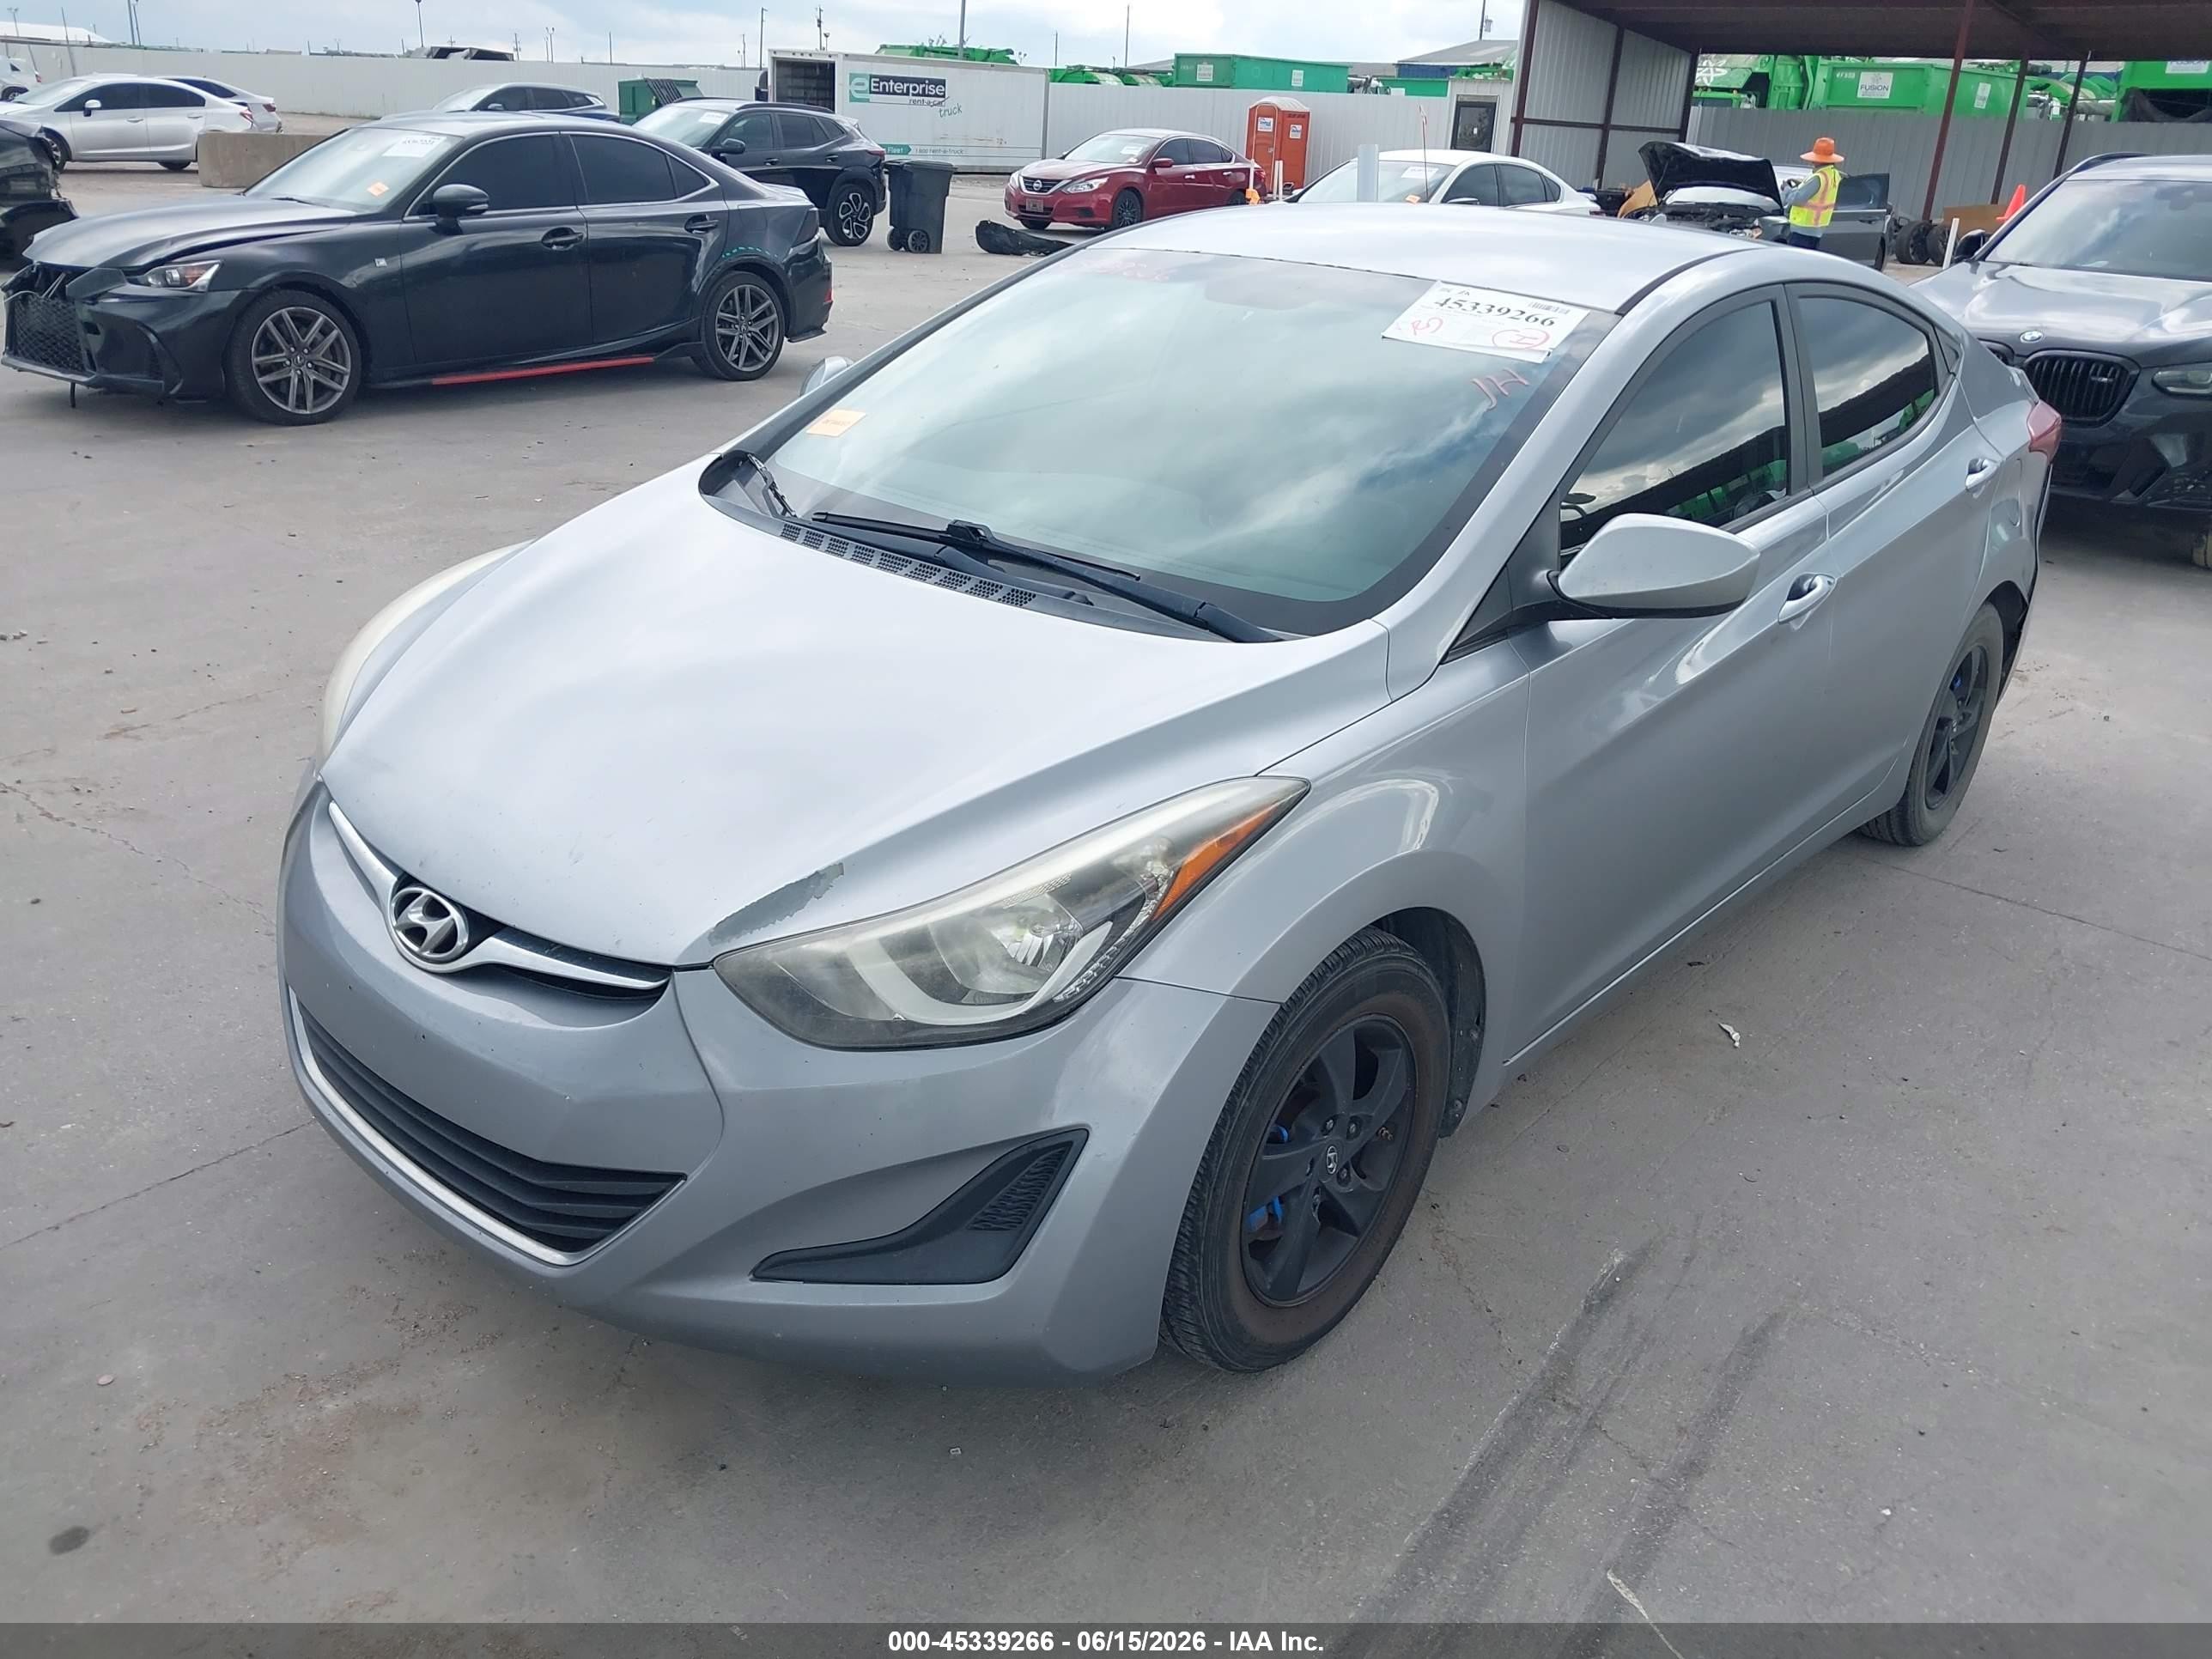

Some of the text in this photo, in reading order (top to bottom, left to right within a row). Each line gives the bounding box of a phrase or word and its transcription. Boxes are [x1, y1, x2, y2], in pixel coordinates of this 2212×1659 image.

[871, 78, 945, 97] Enterprise
[939, 103, 963, 118] truck
[1434, 297, 1558, 327] 45339266
